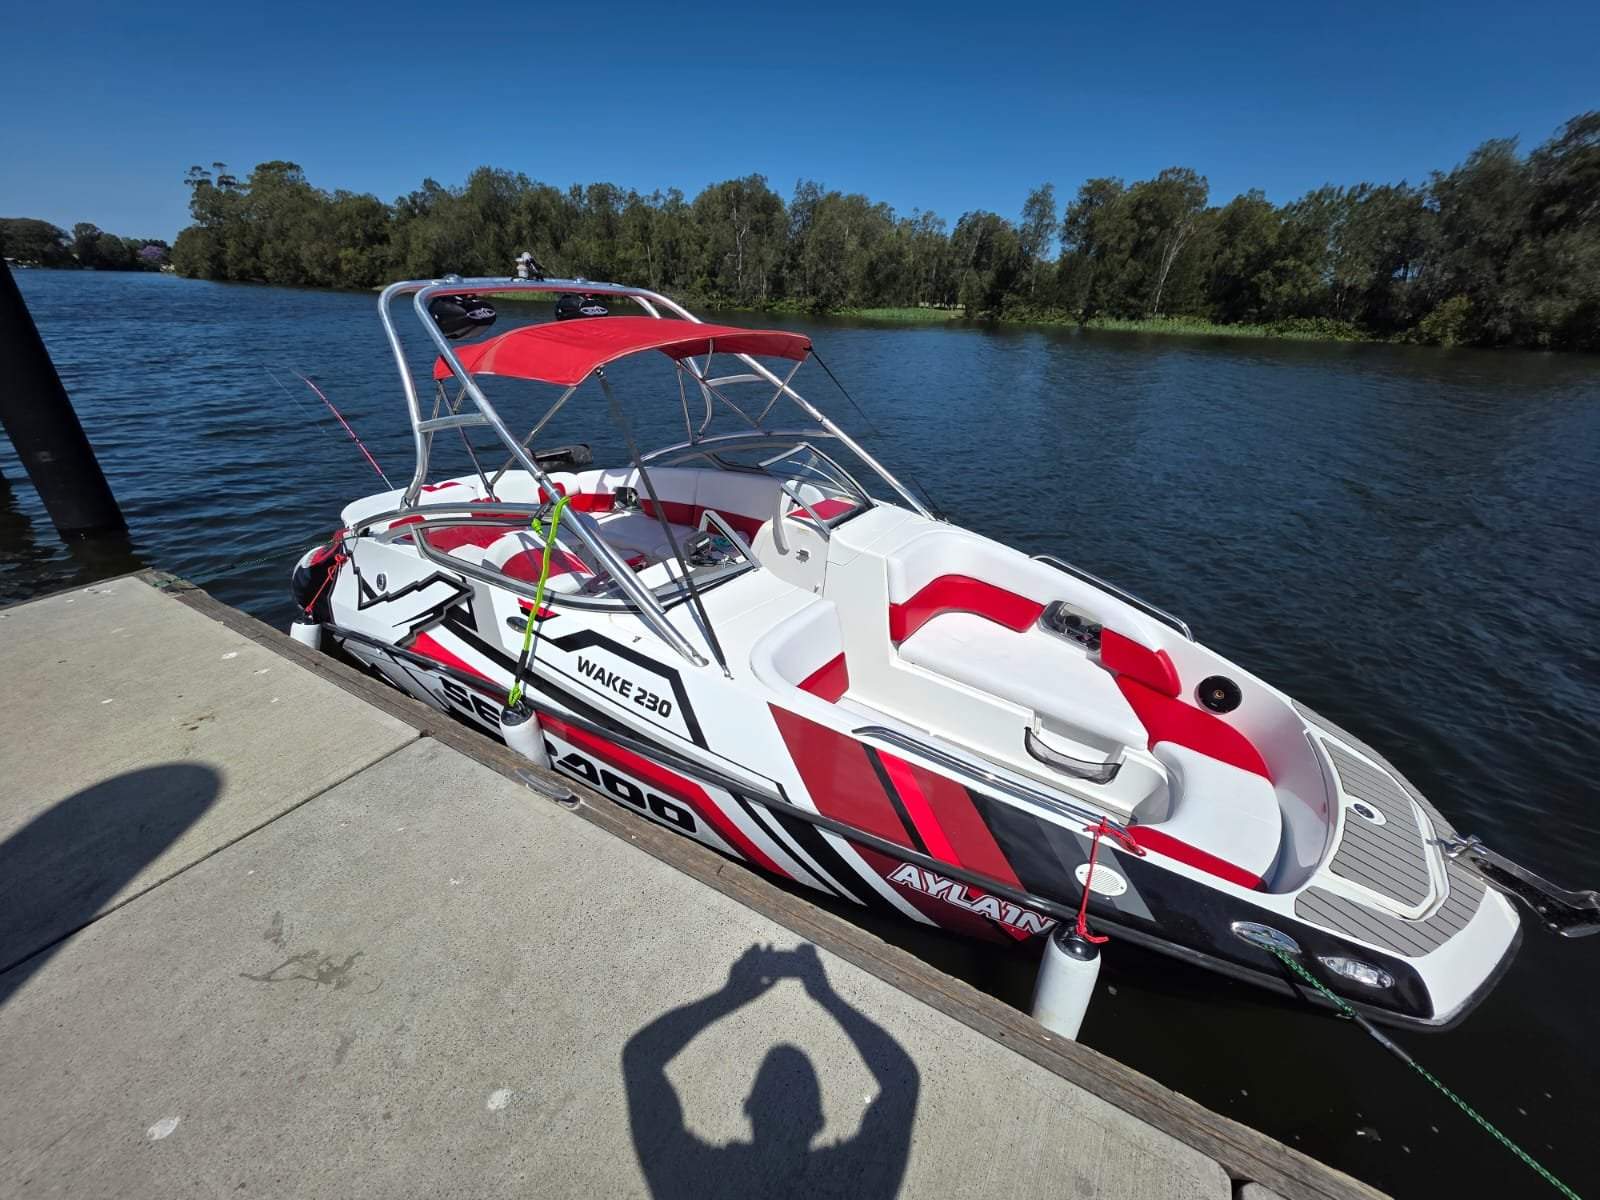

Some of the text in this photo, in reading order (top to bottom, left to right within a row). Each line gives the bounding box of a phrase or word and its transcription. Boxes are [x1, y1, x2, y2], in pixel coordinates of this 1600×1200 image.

[577, 655, 672, 718] WAKE 230
[889, 863, 1057, 935] AYLAIN
